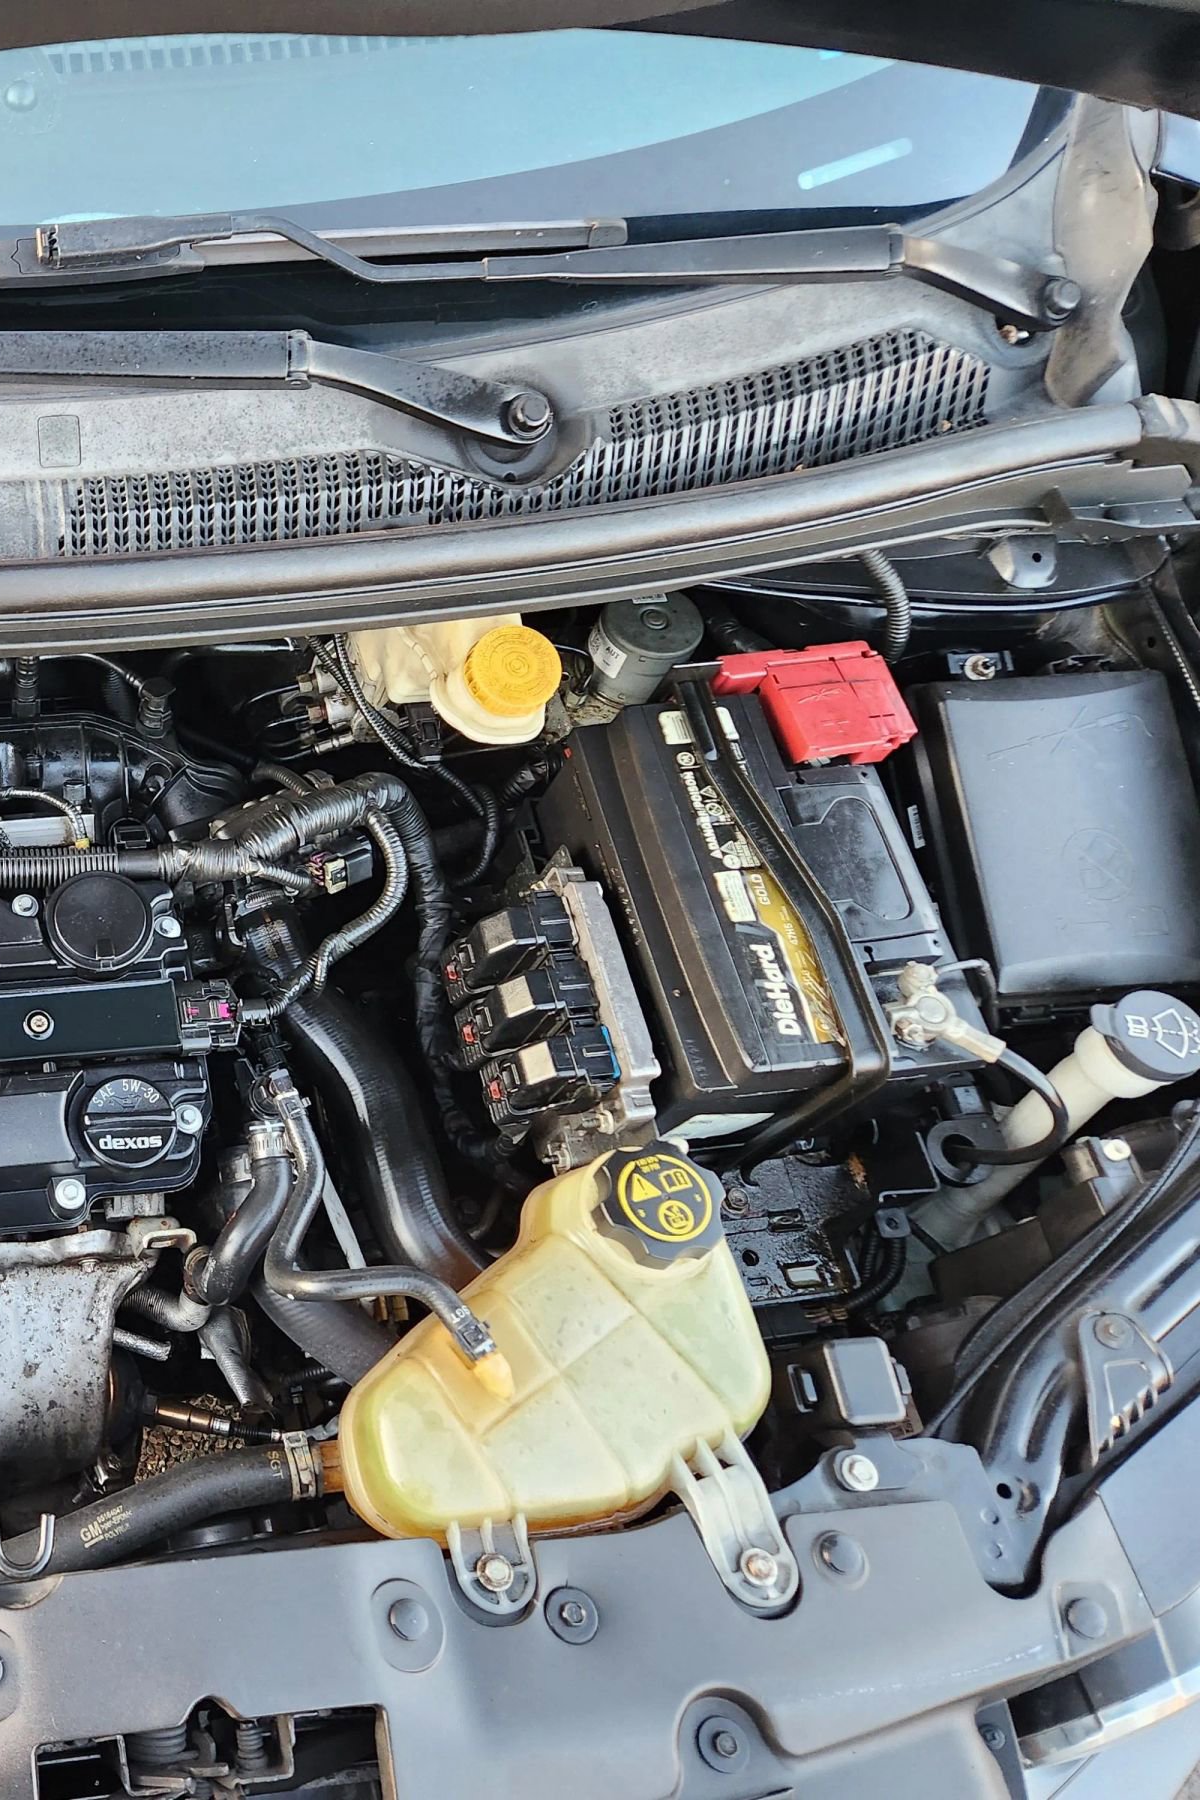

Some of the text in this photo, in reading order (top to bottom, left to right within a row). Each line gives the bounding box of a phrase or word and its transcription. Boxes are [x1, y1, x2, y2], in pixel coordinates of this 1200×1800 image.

[750, 873, 772, 906] GOLD
[92, 1079, 160, 1107] SAE 5W-30
[98, 1134, 163, 1150] dexos
[266, 1450, 285, 1480] SGT
[79, 1520, 103, 1542] GM
